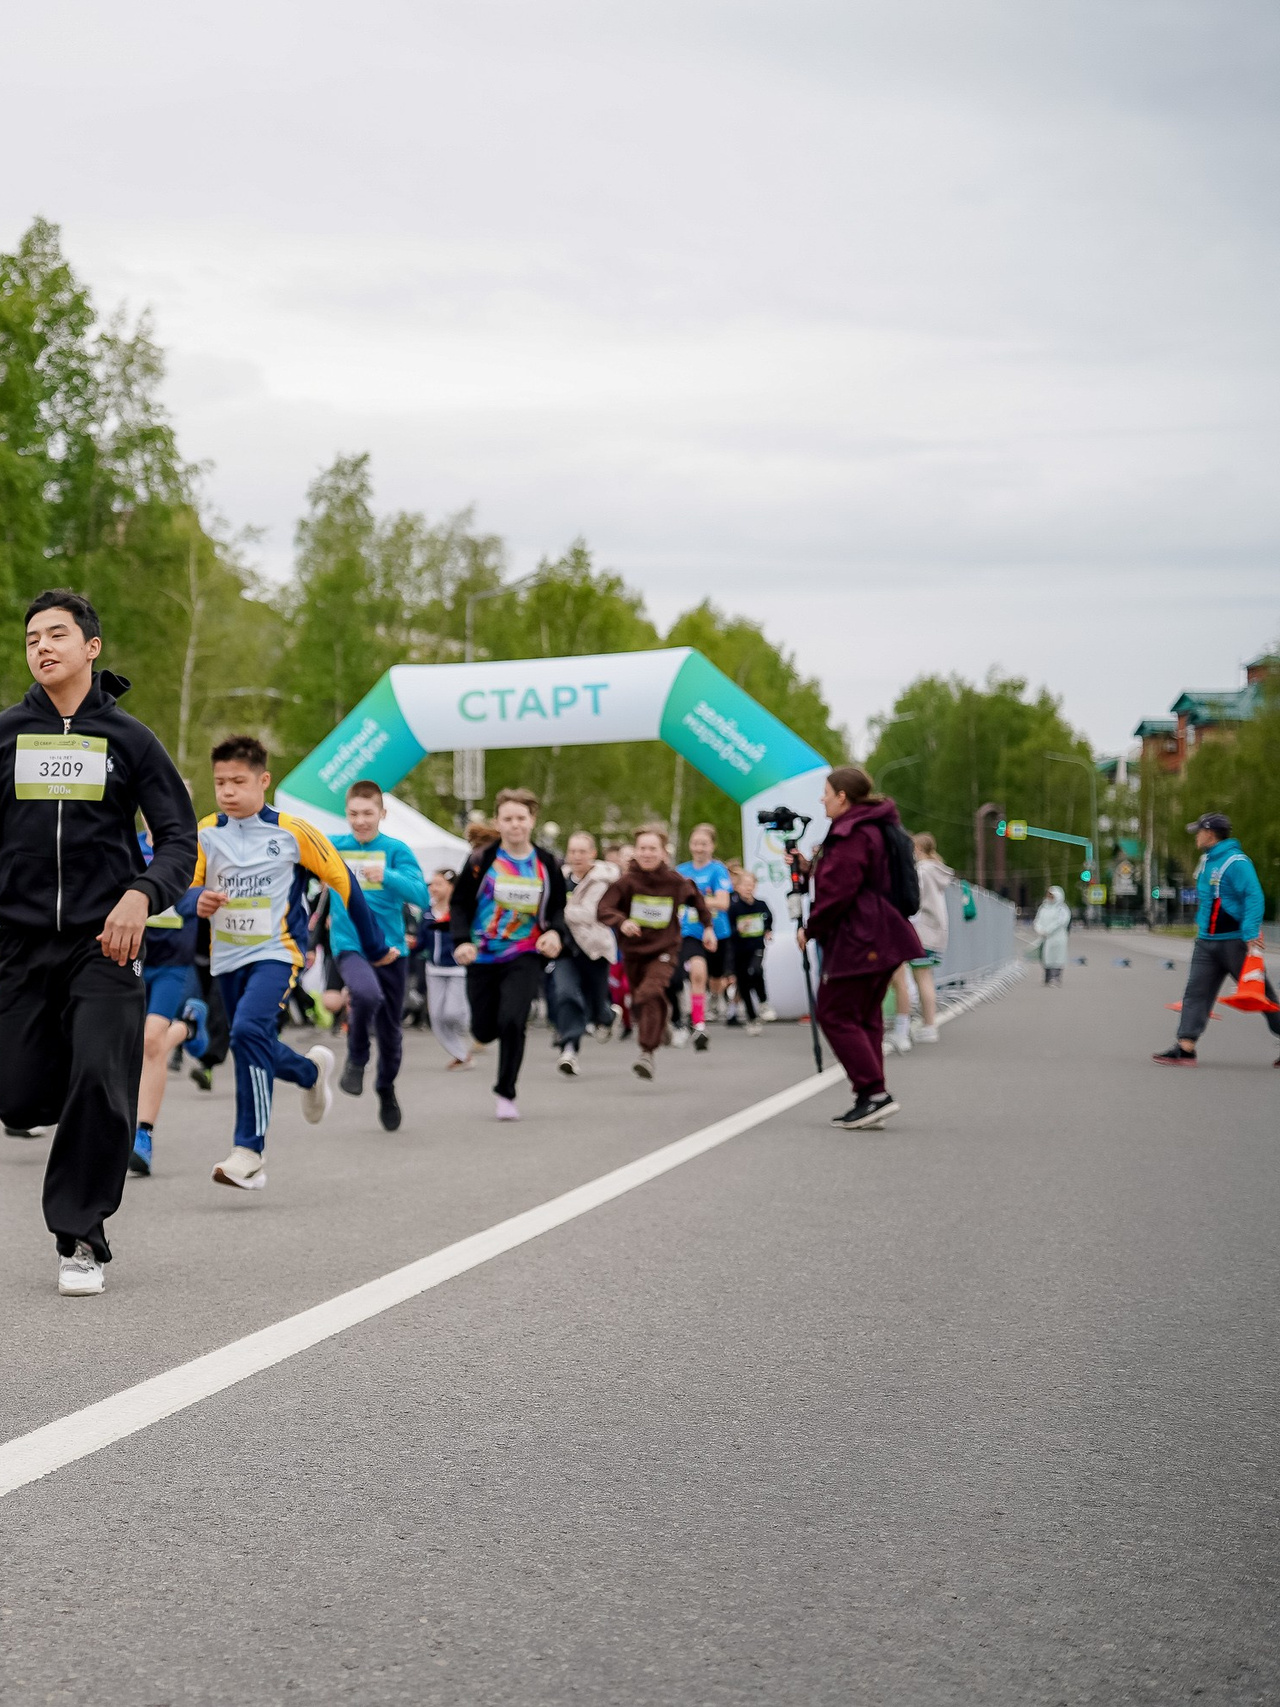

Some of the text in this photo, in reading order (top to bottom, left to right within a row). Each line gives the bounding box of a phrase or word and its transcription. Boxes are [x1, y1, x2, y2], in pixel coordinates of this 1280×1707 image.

[458, 683, 609, 721] СТАРТ
[683, 713, 753, 775] марафон
[39, 762, 84, 777] 3209
[327, 731, 389, 794] марафон
[47, 785, 72, 795] 700м
[217, 873, 273, 889] Emirates
[225, 916, 255, 931] 3127
